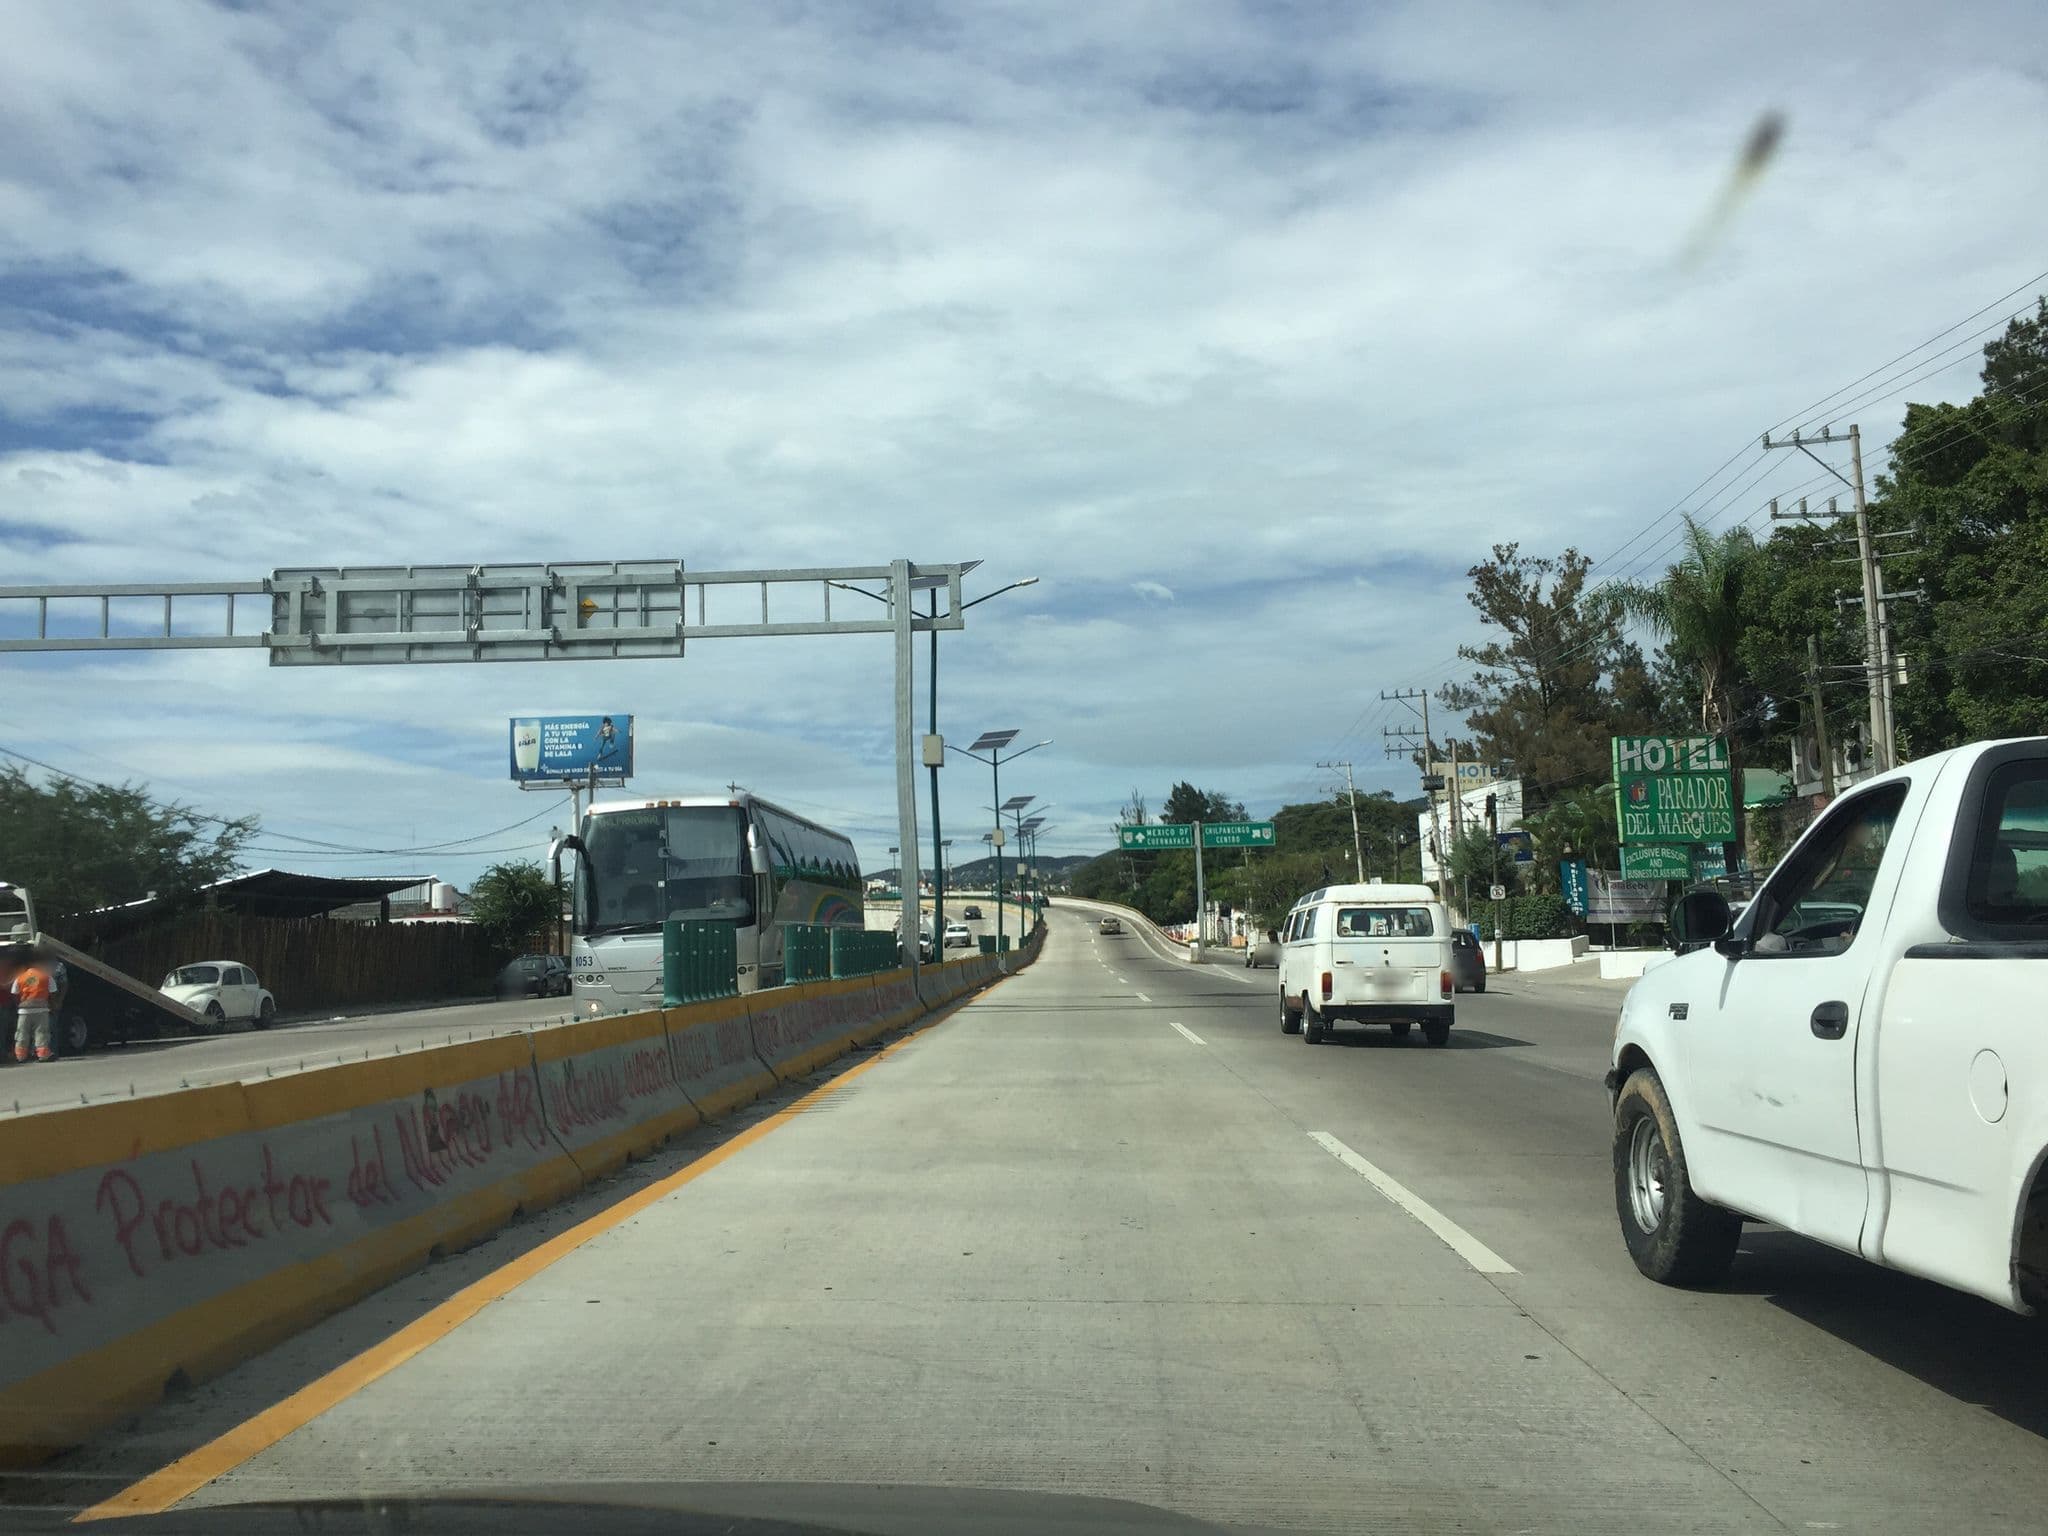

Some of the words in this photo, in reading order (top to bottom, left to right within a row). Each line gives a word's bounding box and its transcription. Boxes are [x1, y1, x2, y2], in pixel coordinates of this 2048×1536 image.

[1620, 738, 1726, 772] HOTEL
[1657, 777, 1730, 810] PARADOR
[1205, 826, 1250, 835] CHILPANCINGO
[1625, 813, 1655, 836] DEL
[1657, 811, 1732, 839] MARQUES
[1146, 828, 1175, 837] MEXICO
[1147, 837, 1190, 845] CUERNAVACA
[1216, 836, 1240, 844] CENTRO
[1626, 847, 1660, 866] EXCLUSIVE
[1650, 858, 1663, 868] AND
[1626, 869, 1652, 879] BUSINESS
[1653, 868, 1670, 878] CLASS
[1671, 868, 1689, 878] HOTEL
[575, 955, 593, 967] 1053
[97, 1143, 332, 1278] Protector
[347, 1125, 398, 1207] del
